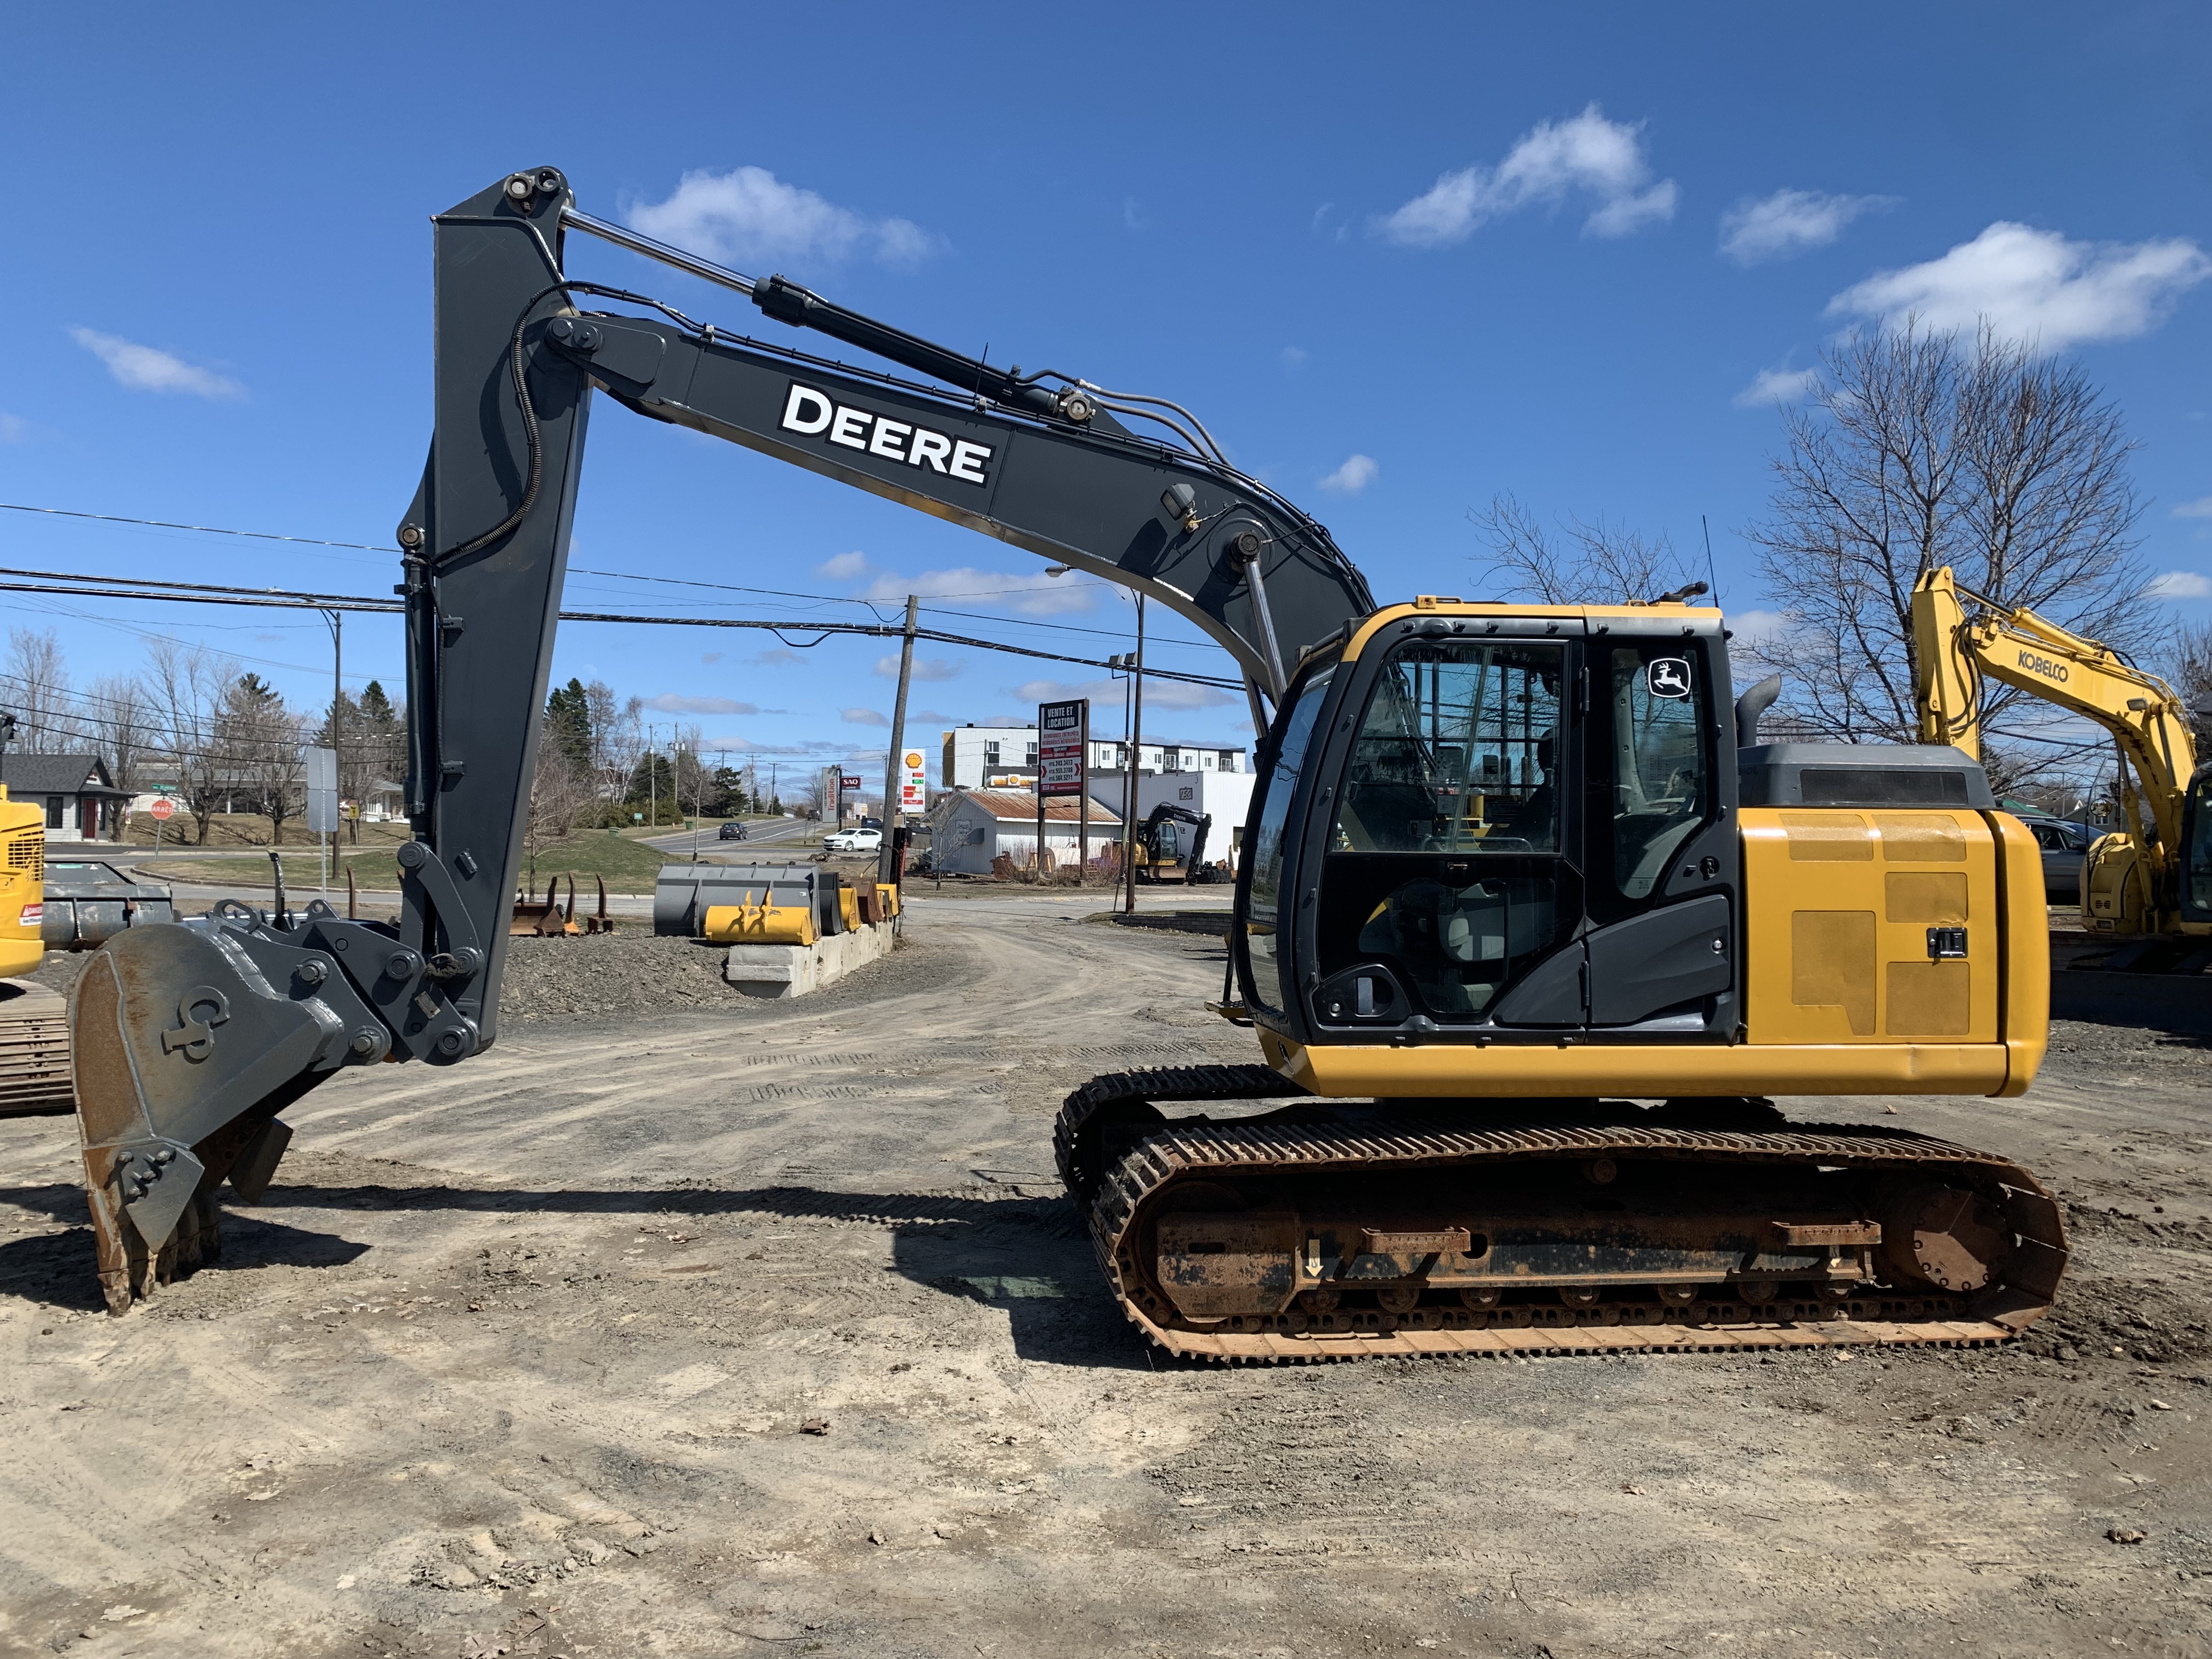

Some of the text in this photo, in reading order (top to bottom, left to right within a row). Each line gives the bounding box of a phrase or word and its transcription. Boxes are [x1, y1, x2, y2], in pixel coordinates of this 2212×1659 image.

[782, 384, 991, 483] DEERE
[2018, 649, 2068, 682] KOBELCO
[1047, 706, 1073, 718] VENTE ET
[1047, 716, 1075, 728] LOCATION
